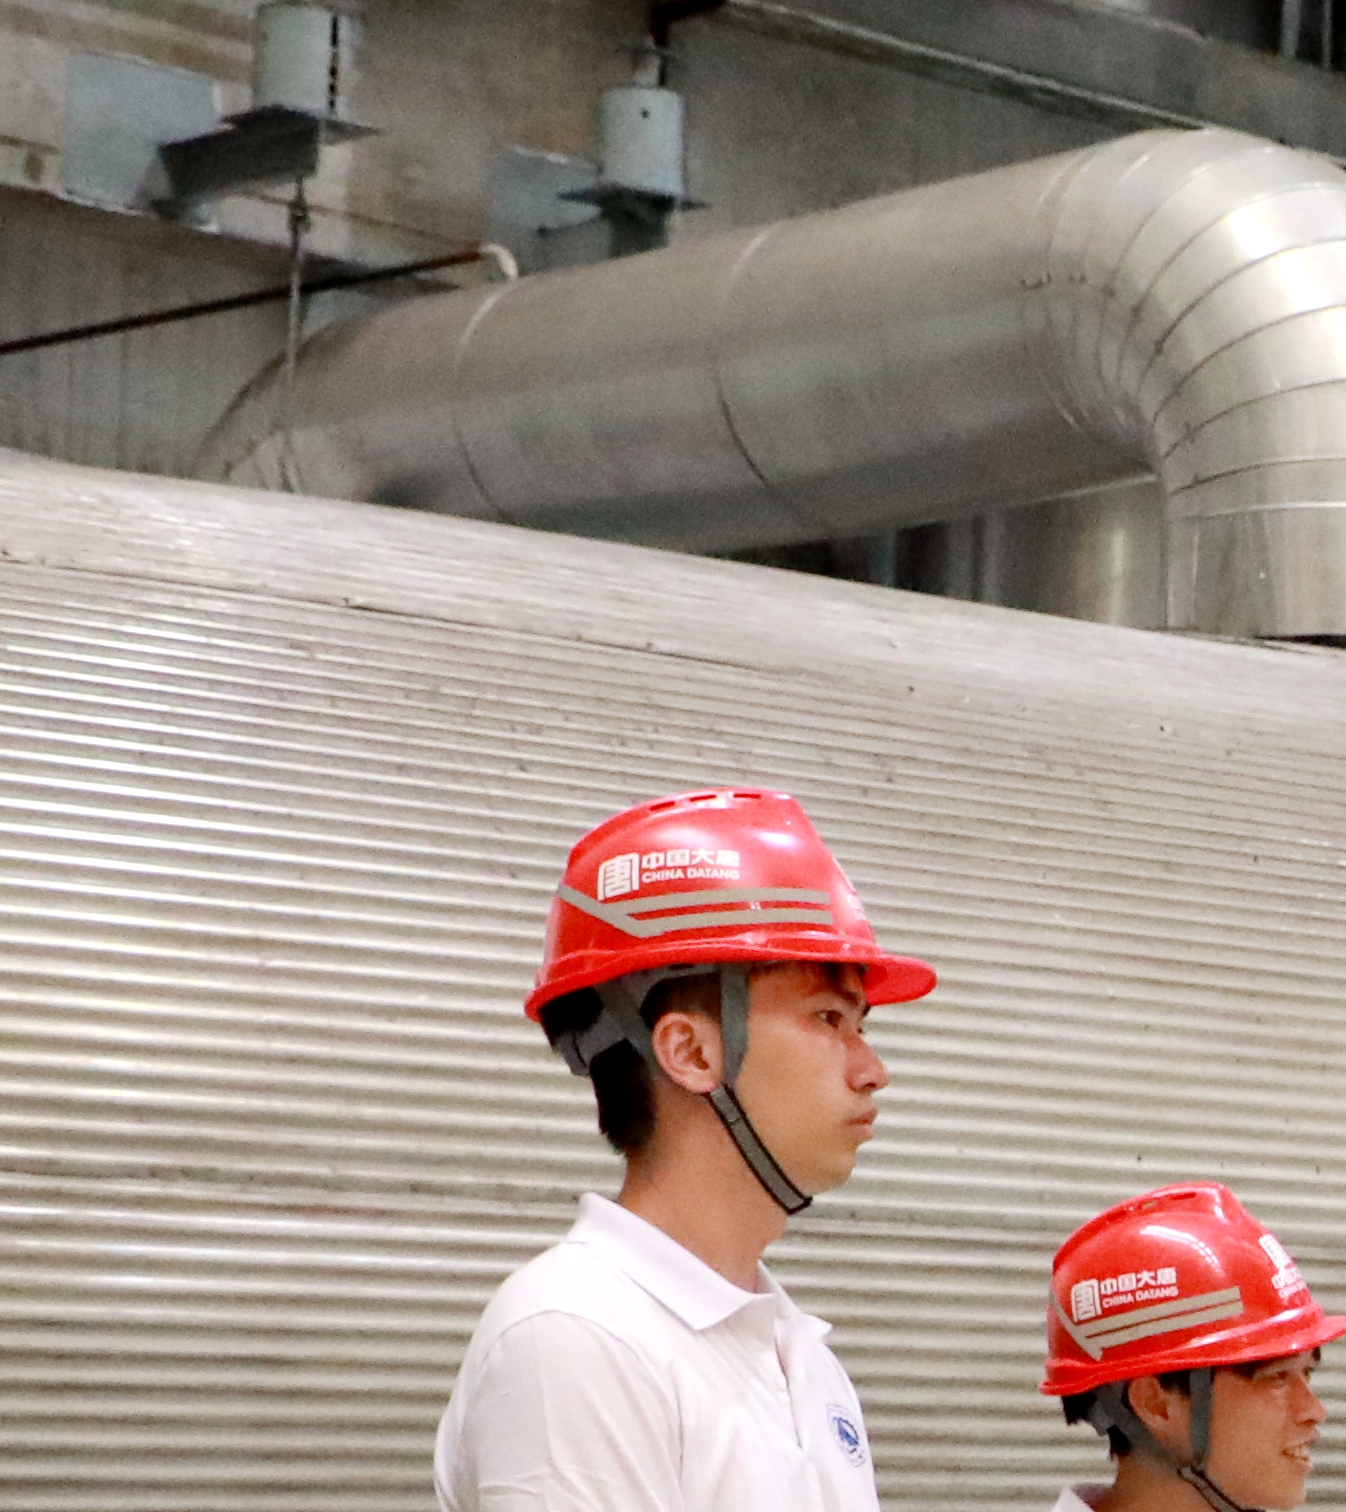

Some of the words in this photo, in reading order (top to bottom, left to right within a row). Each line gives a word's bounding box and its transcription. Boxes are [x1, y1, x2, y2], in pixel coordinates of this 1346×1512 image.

[641, 849, 740, 870] 中国大唐
[641, 868, 685, 884] CHINA
[686, 866, 741, 881] DATANG
[1100, 1266, 1177, 1295] 中国大唐
[1102, 1292, 1135, 1309] CHINA
[1135, 1286, 1179, 1302] DATANG
